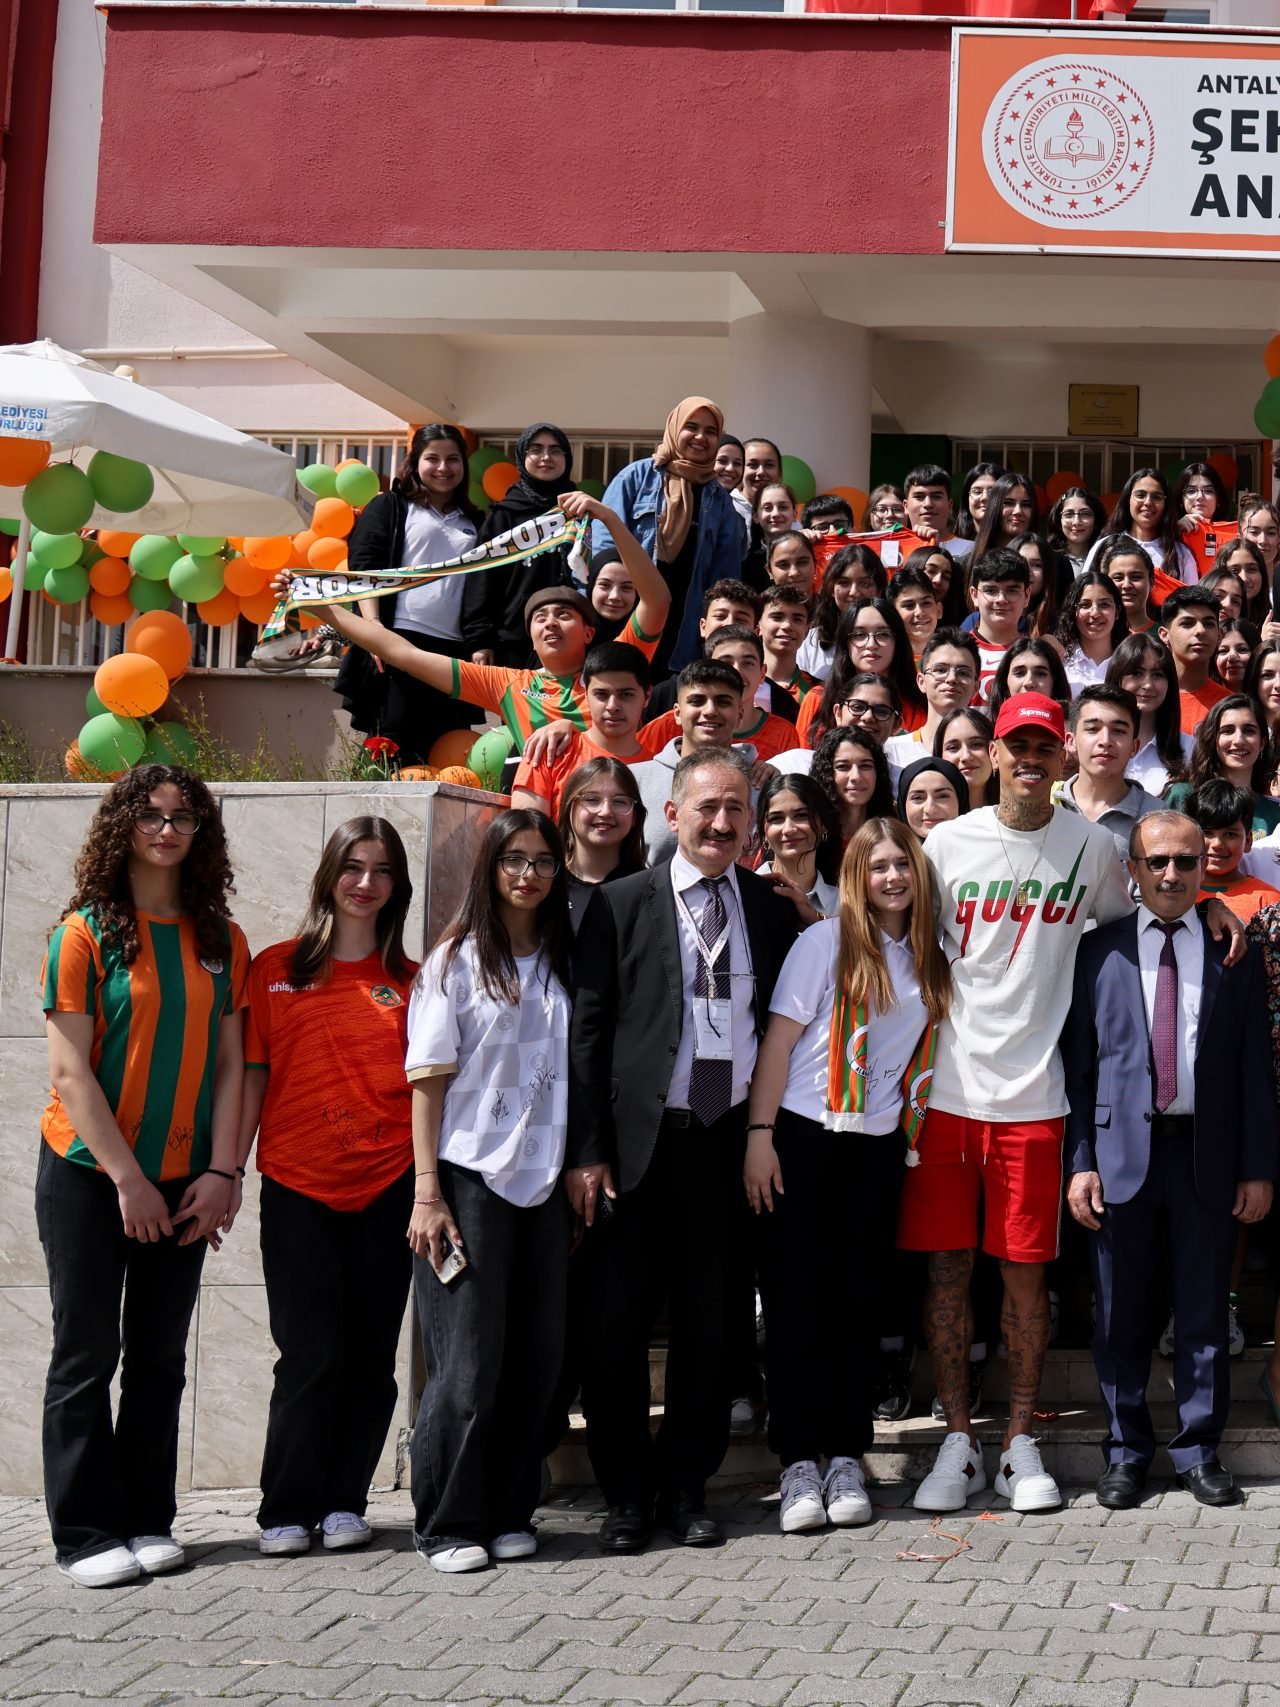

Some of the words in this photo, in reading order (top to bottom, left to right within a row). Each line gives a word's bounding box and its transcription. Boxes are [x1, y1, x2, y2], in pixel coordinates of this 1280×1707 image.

[1101, 104, 1125, 138] EĞİTİM
[1086, 141, 1125, 189] BAKANLIĞI
[0, 405, 48, 419] EDİYESİ
[1019, 708, 1050, 718] Supreme
